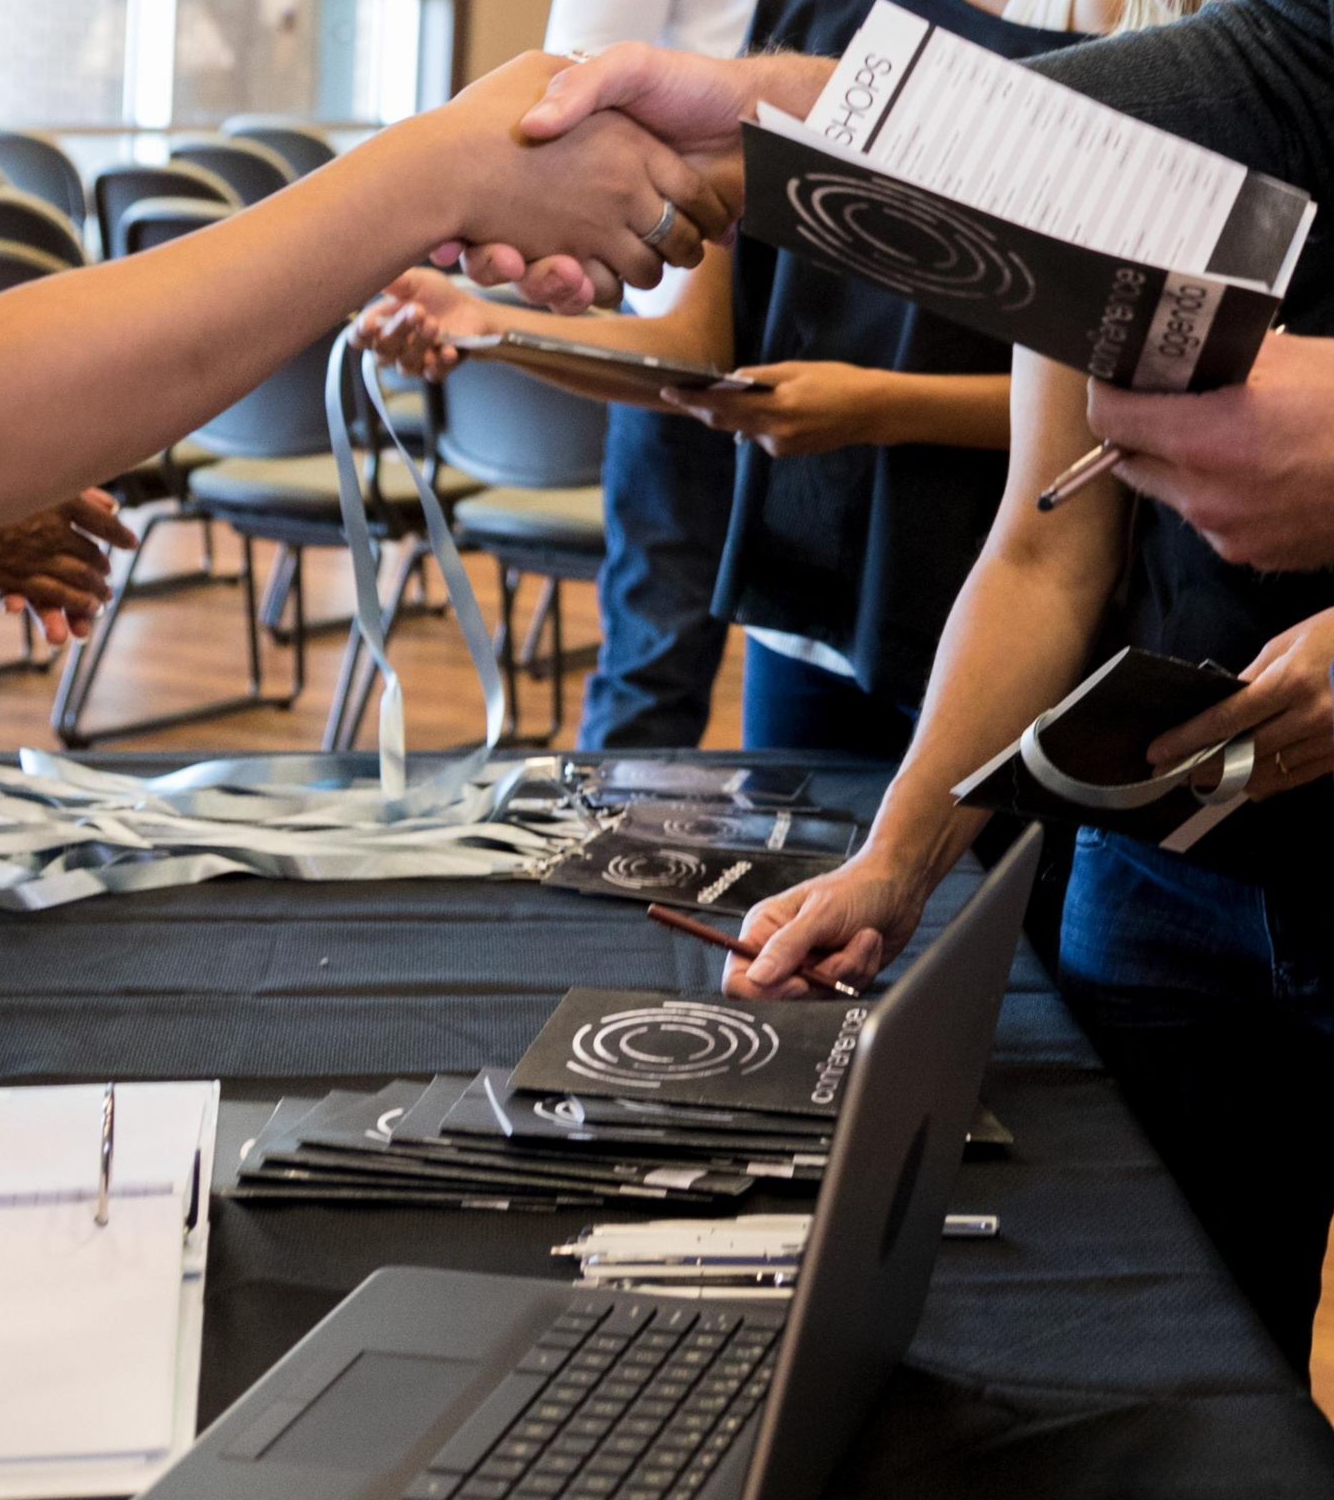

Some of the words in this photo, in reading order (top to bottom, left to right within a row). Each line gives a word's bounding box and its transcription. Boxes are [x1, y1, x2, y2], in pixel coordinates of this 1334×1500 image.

[824, 52, 892, 147] SHOPS
[1086, 267, 1146, 379] conference
[1158, 283, 1207, 358] agenda
[810, 1007, 867, 1105] conference
